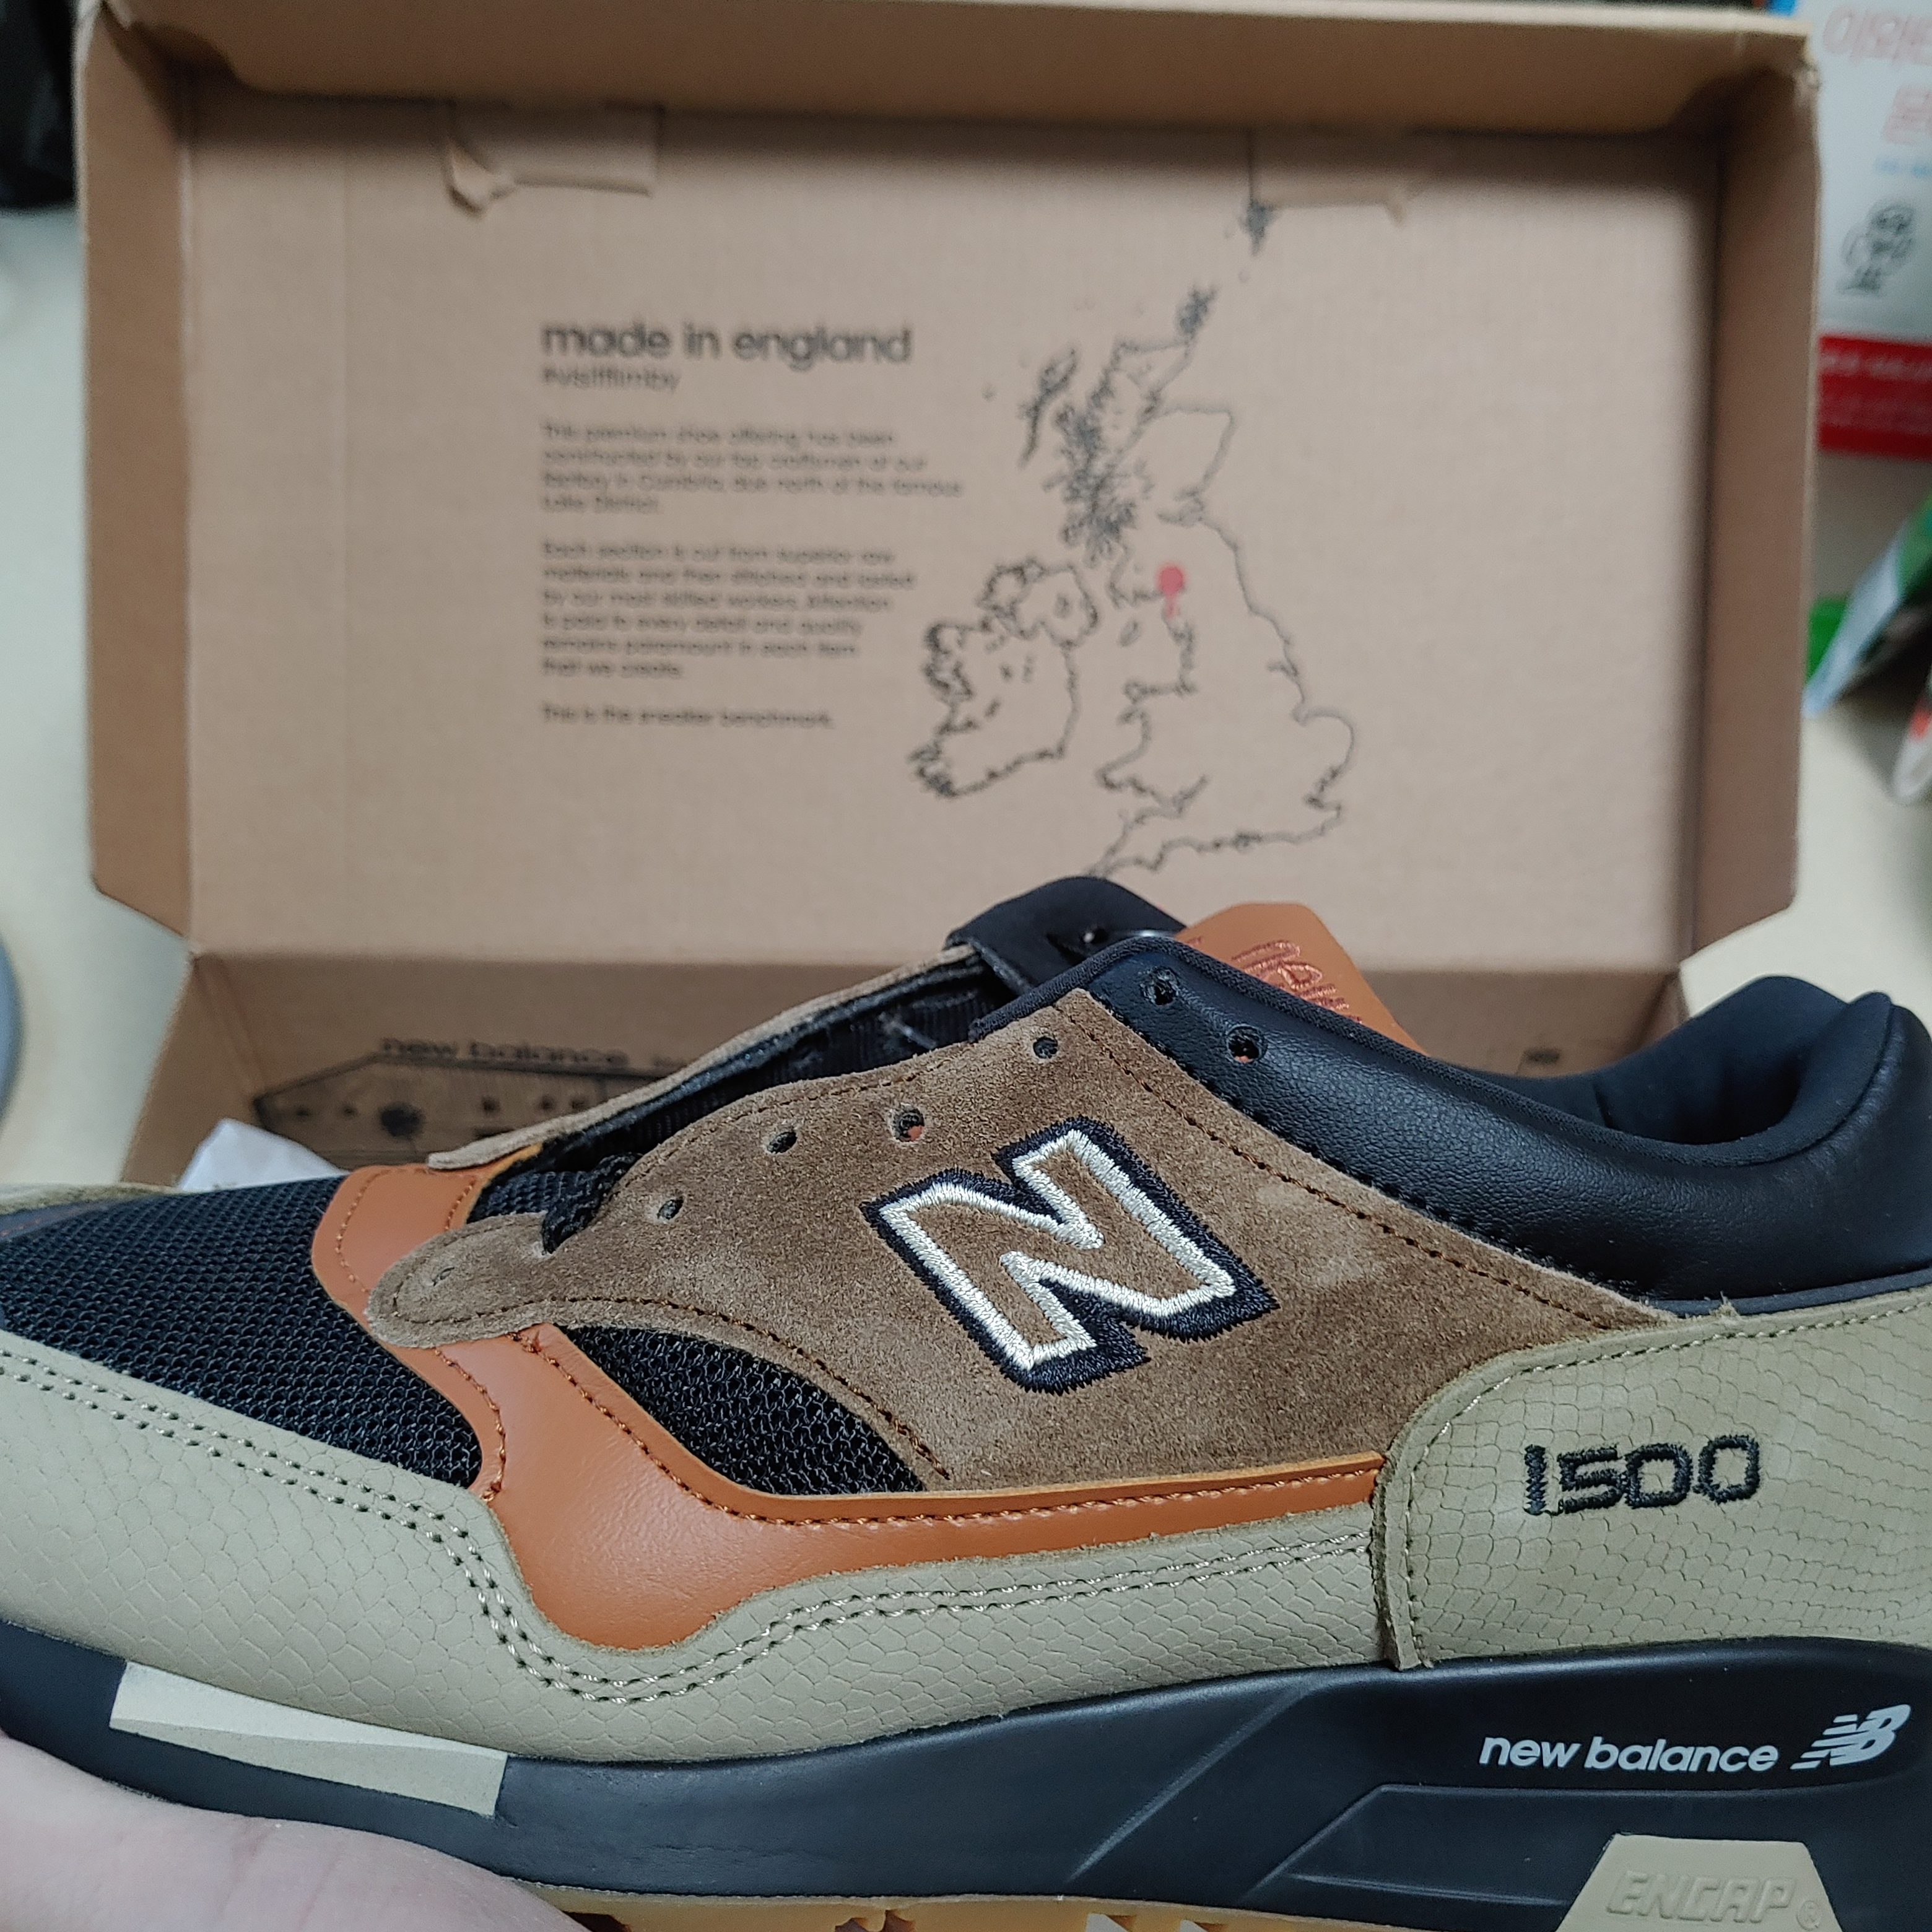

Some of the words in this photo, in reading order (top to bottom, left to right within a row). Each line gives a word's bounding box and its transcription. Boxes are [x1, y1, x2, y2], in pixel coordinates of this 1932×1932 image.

[541, 324, 670, 357] made
[683, 323, 719, 359] in
[733, 326, 911, 372] england
[861, 1115, 1281, 1395] N
[1524, 1434, 1760, 1516] 1500
[1479, 1736, 1582, 1768] new
[1583, 1736, 1779, 1772] balance
[1606, 1869, 1797, 1924] ENCAP
